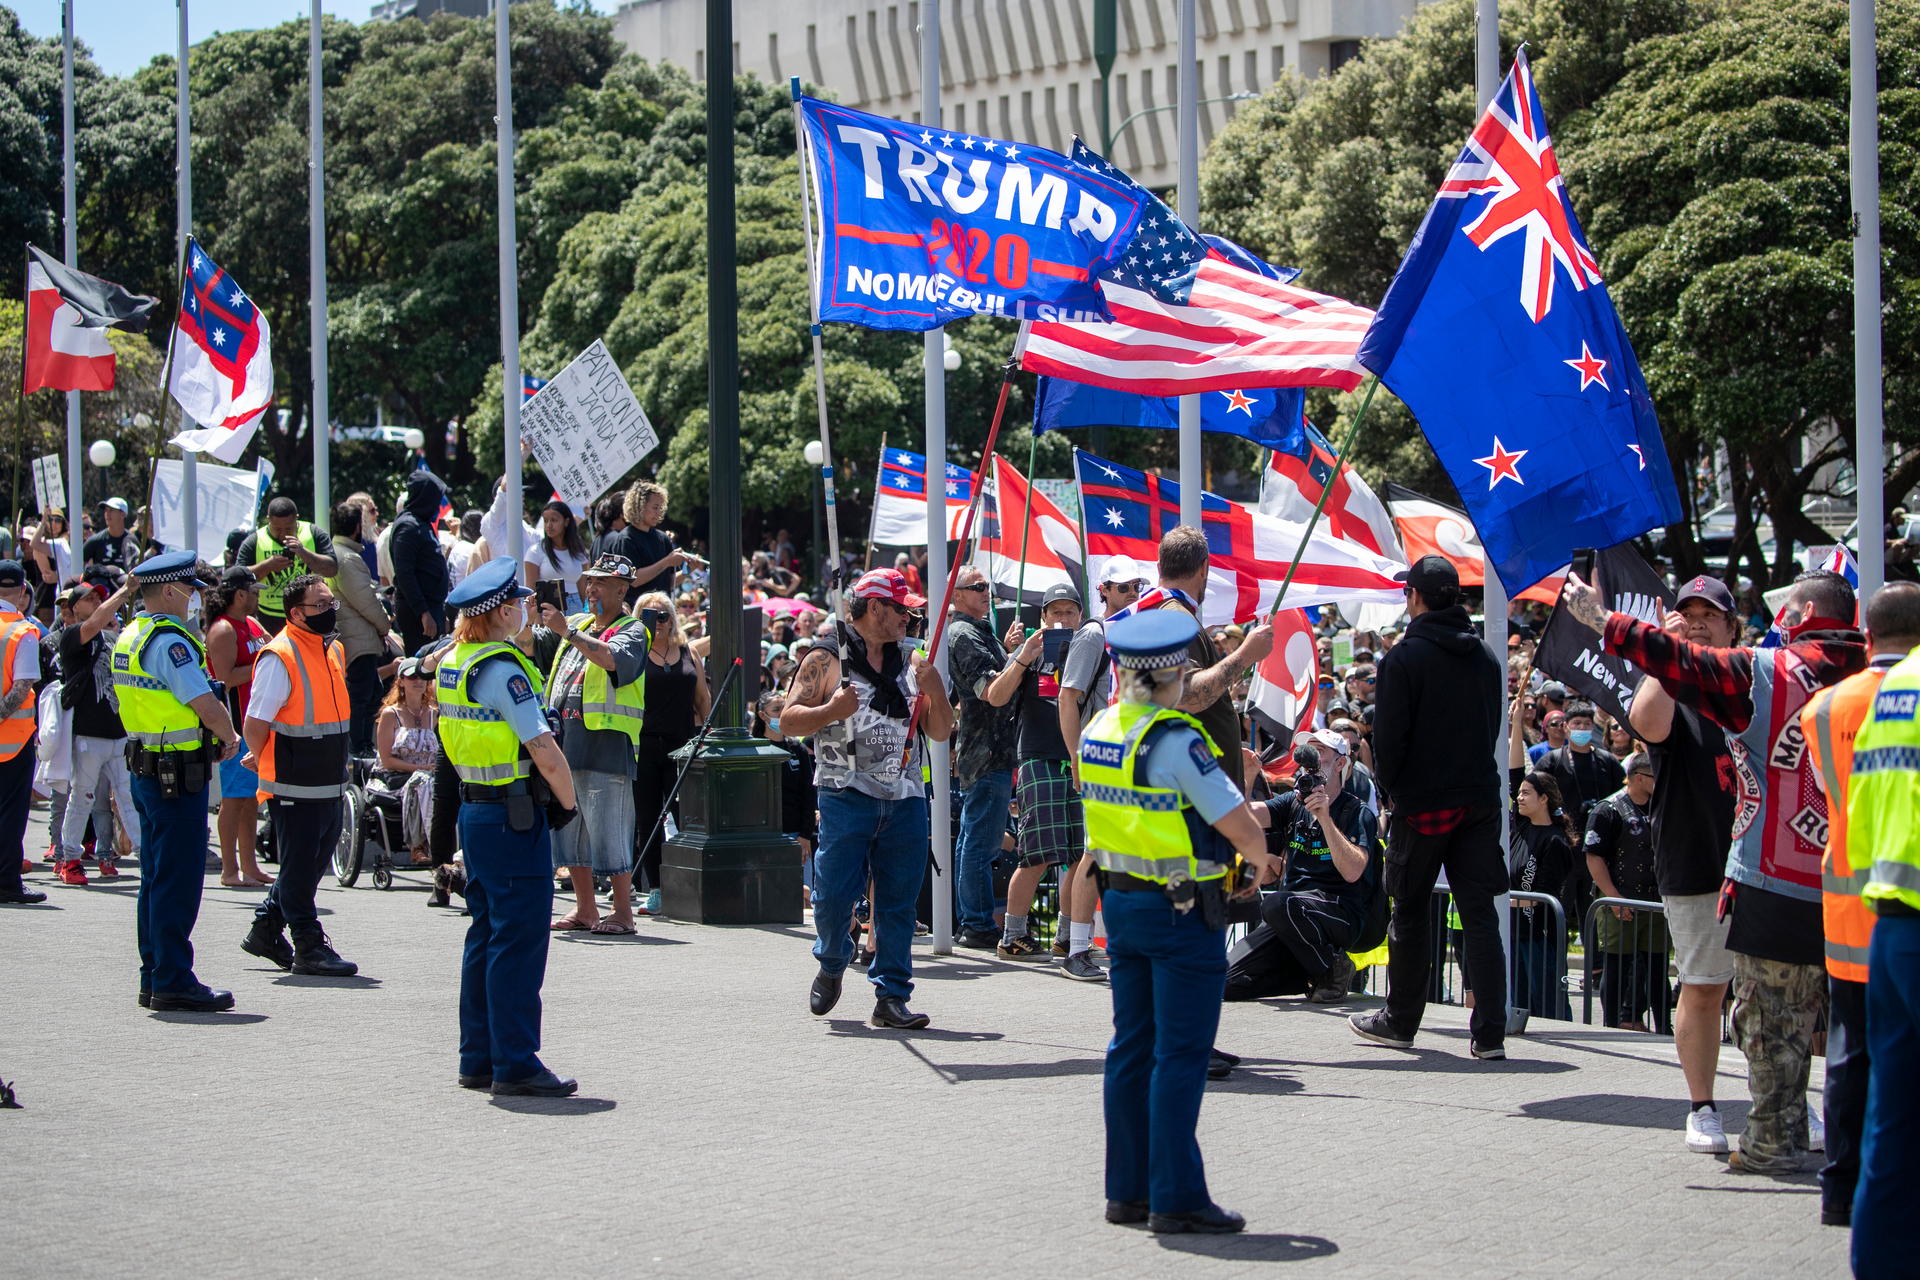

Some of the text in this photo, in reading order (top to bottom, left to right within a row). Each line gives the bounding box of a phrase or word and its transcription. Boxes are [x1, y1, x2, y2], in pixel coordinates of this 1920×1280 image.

[837, 125, 1117, 242] TRUMP
[929, 217, 1030, 290] 2020
[846, 265, 894, 301] NO
[540, 390, 553, 407] CHILD
[579, 343, 654, 458] PANTS ON FIRE
[577, 387, 618, 450] JACINDA
[580, 452, 589, 464] AND
[584, 439, 593, 451] THE
[590, 450, 599, 464] VAX
[567, 478, 576, 492] FULL
[569, 464, 586, 491] LABOUR
[115, 656, 129, 668] POLICE
[1573, 648, 1617, 690] New
[440, 672, 456, 685] POLICE
[516, 693, 533, 702] POLICE
[1877, 694, 1917, 715] POLICE
[865, 736, 883, 745] LOS
[872, 728, 893, 736] NEW
[1083, 743, 1121, 763] POLICE
